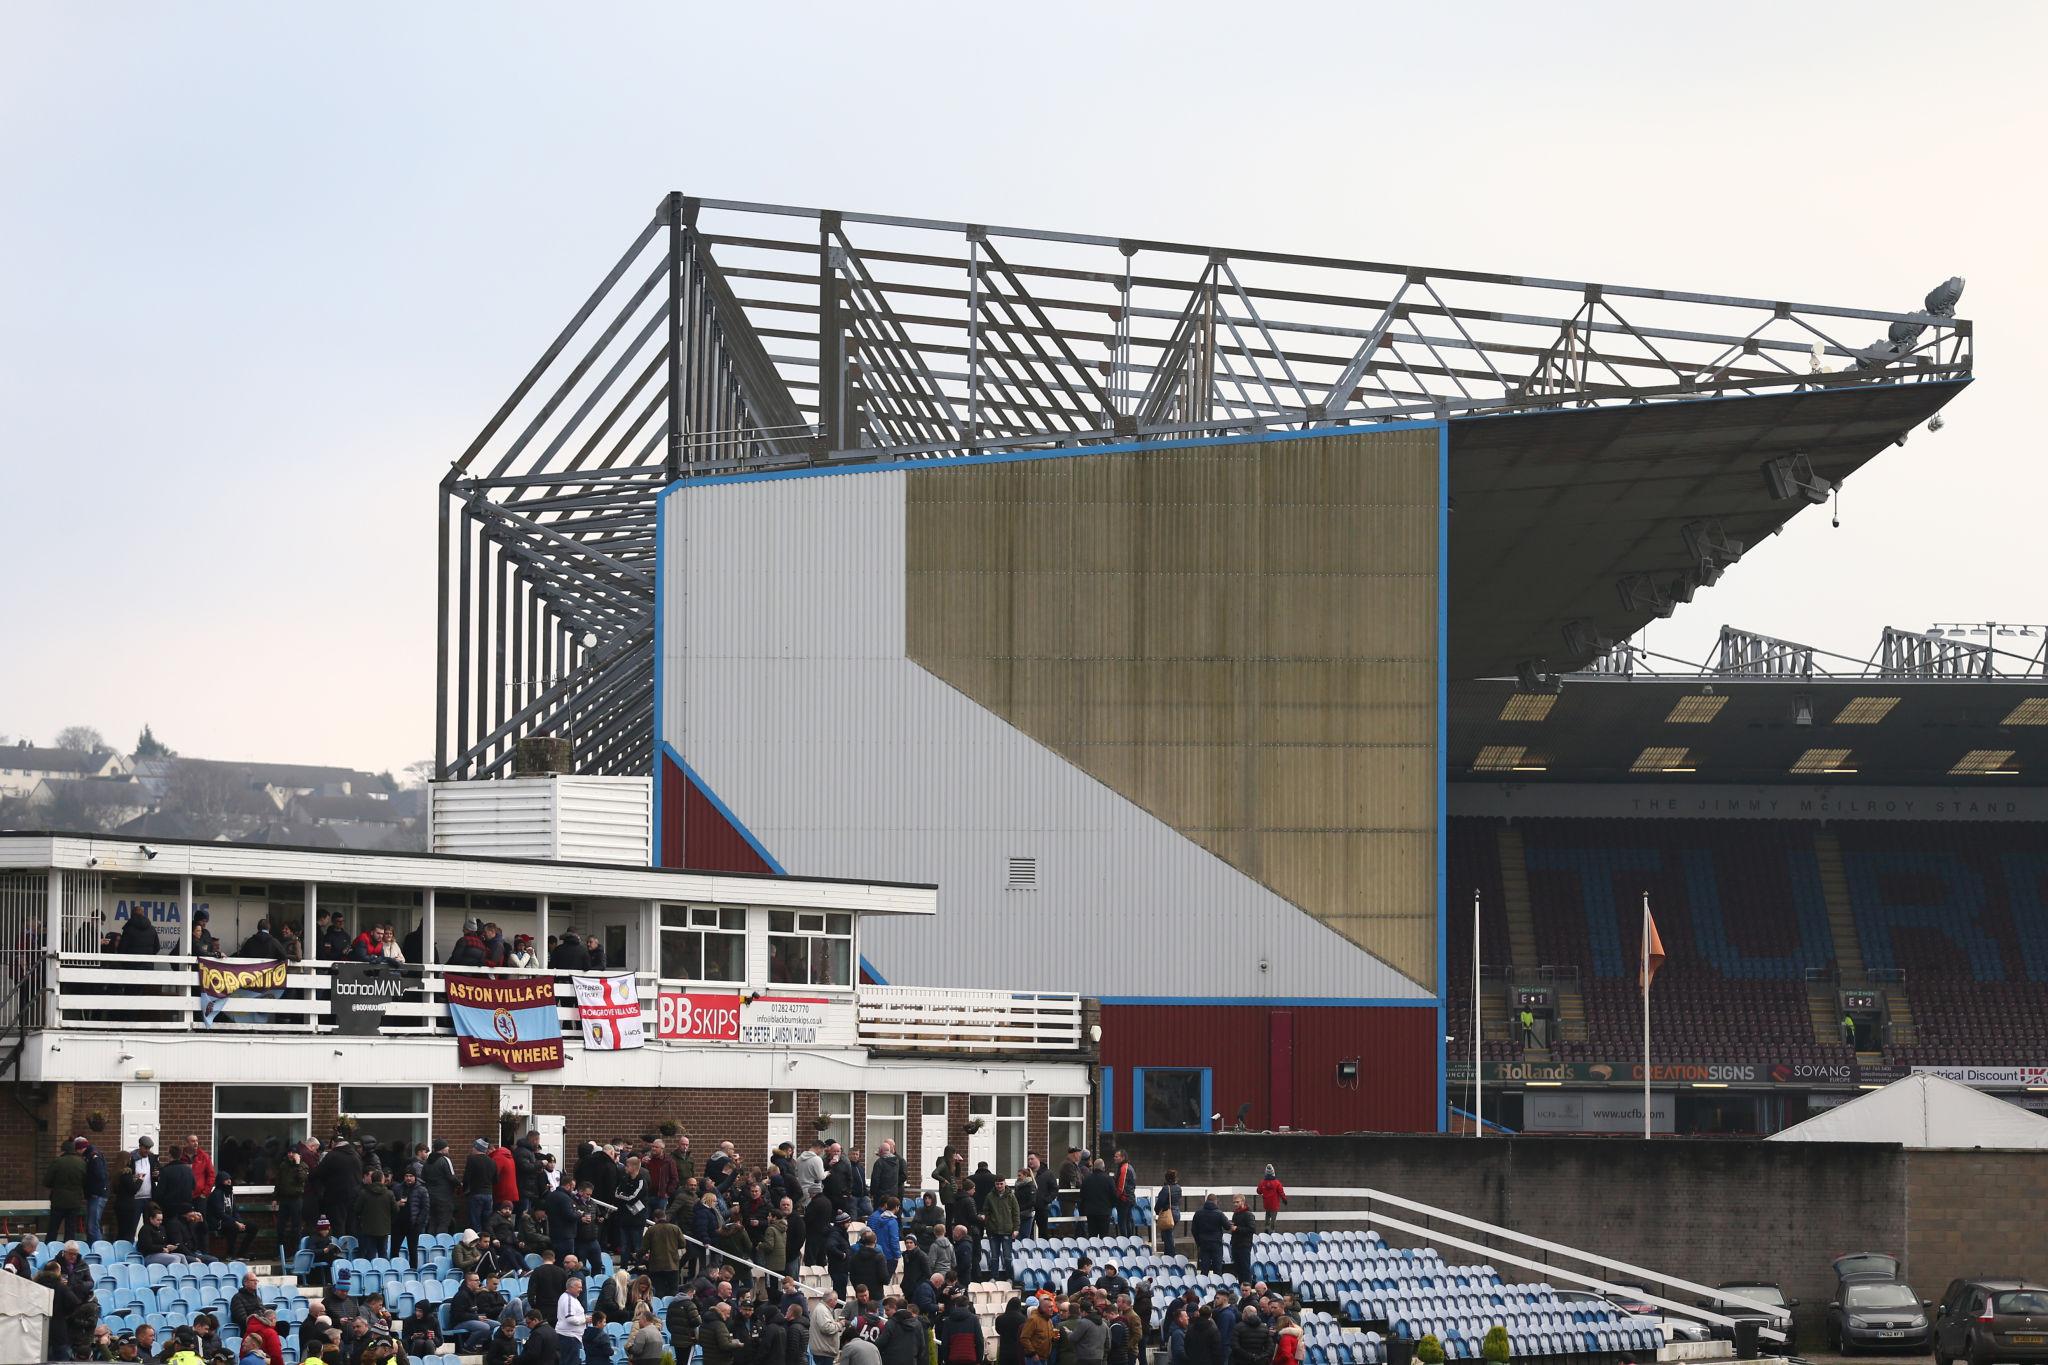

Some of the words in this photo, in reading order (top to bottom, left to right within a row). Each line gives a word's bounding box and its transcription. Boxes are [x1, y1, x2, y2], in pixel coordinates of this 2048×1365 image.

[1632, 799, 1678, 810] THE
[1697, 799, 1776, 811] JIMMY
[1800, 800, 1914, 812] McILROY
[1936, 801, 2017, 813] STAND
[199, 962, 287, 994] TORONTO
[450, 982, 493, 1002] ASTON
[494, 986, 535, 1003] VILLA
[535, 983, 553, 999] FC
[659, 997, 692, 1034] BB
[692, 1008, 738, 1036] SKIPS
[742, 1026, 752, 1042] THE
[754, 1026, 770, 1042] PETER
[771, 1027, 793, 1043] LAWSON
[793, 1027, 816, 1043] PAVILION
[1494, 1063, 1574, 1080] Holland's
[1794, 1064, 1851, 1077] SOYANG
[1968, 1070, 2017, 1081] Discount
[859, 1324, 880, 1342] 40
